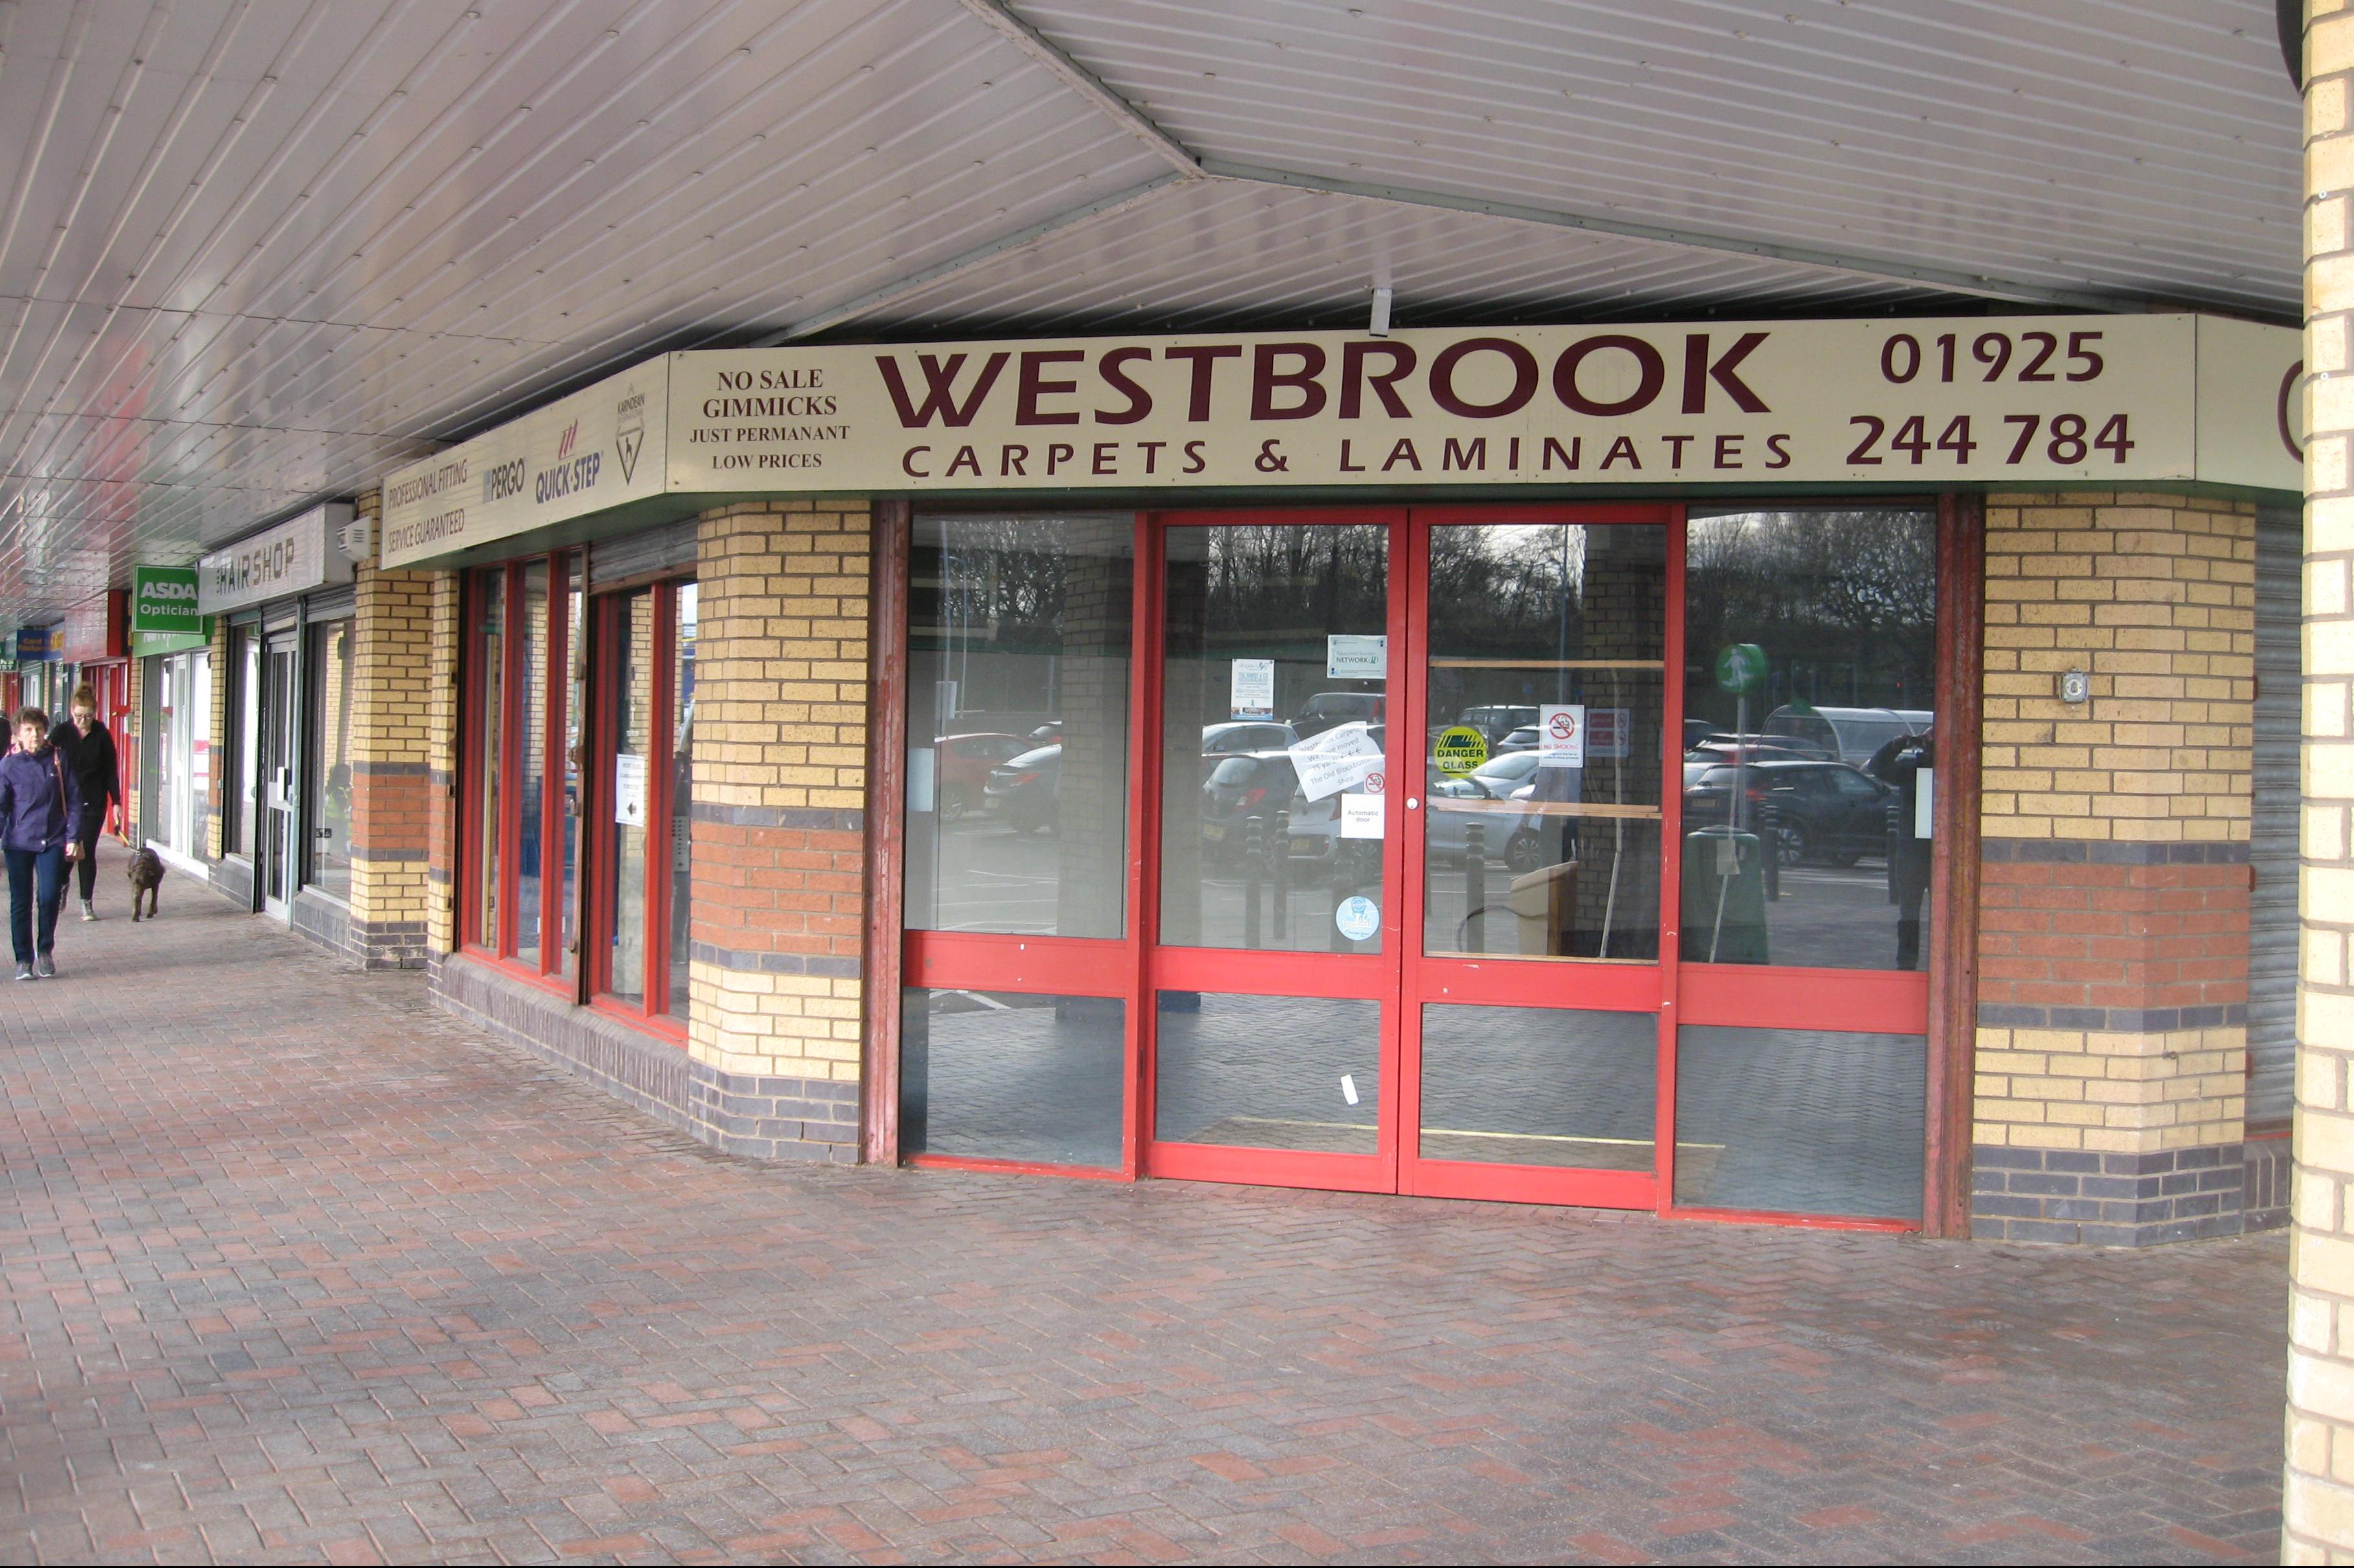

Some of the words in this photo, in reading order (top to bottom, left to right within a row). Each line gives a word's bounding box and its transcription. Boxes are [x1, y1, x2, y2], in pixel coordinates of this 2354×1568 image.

[1880, 331, 2104, 383] 01925
[717, 370, 753, 391] NO
[760, 369, 823, 390] SALE
[874, 332, 1772, 428] WESTBROOK
[703, 395, 837, 418] GIMMICKS
[689, 427, 732, 443] JUST
[736, 426, 851, 442] PERMANANT
[1845, 415, 1977, 466] 244
[2003, 413, 2135, 465] 784
[712, 455, 754, 470] LOW
[759, 453, 823, 469] PRICES
[902, 440, 1207, 478] CARPETS
[1254, 438, 1290, 473] &
[1339, 433, 1792, 472] LAMINATES
[388, 472, 437, 510] PROFESSIONAL
[439, 458, 467, 492] FITTING
[491, 457, 525, 501] PERGO
[388, 525, 414, 554] SERVICE
[415, 508, 465, 546] GUARANTEED
[219, 554, 249, 595] HAIR
[253, 538, 295, 585] SHOP
[140, 582, 198, 600] ASDA
[140, 604, 198, 616] Optician
[1337, 736, 1360, 751] moved
[1437, 749, 1483, 758] DANGER
[1443, 761, 1478, 769] GLASS
[1310, 775, 1323, 785] The
[1323, 769, 1336, 780] Old
